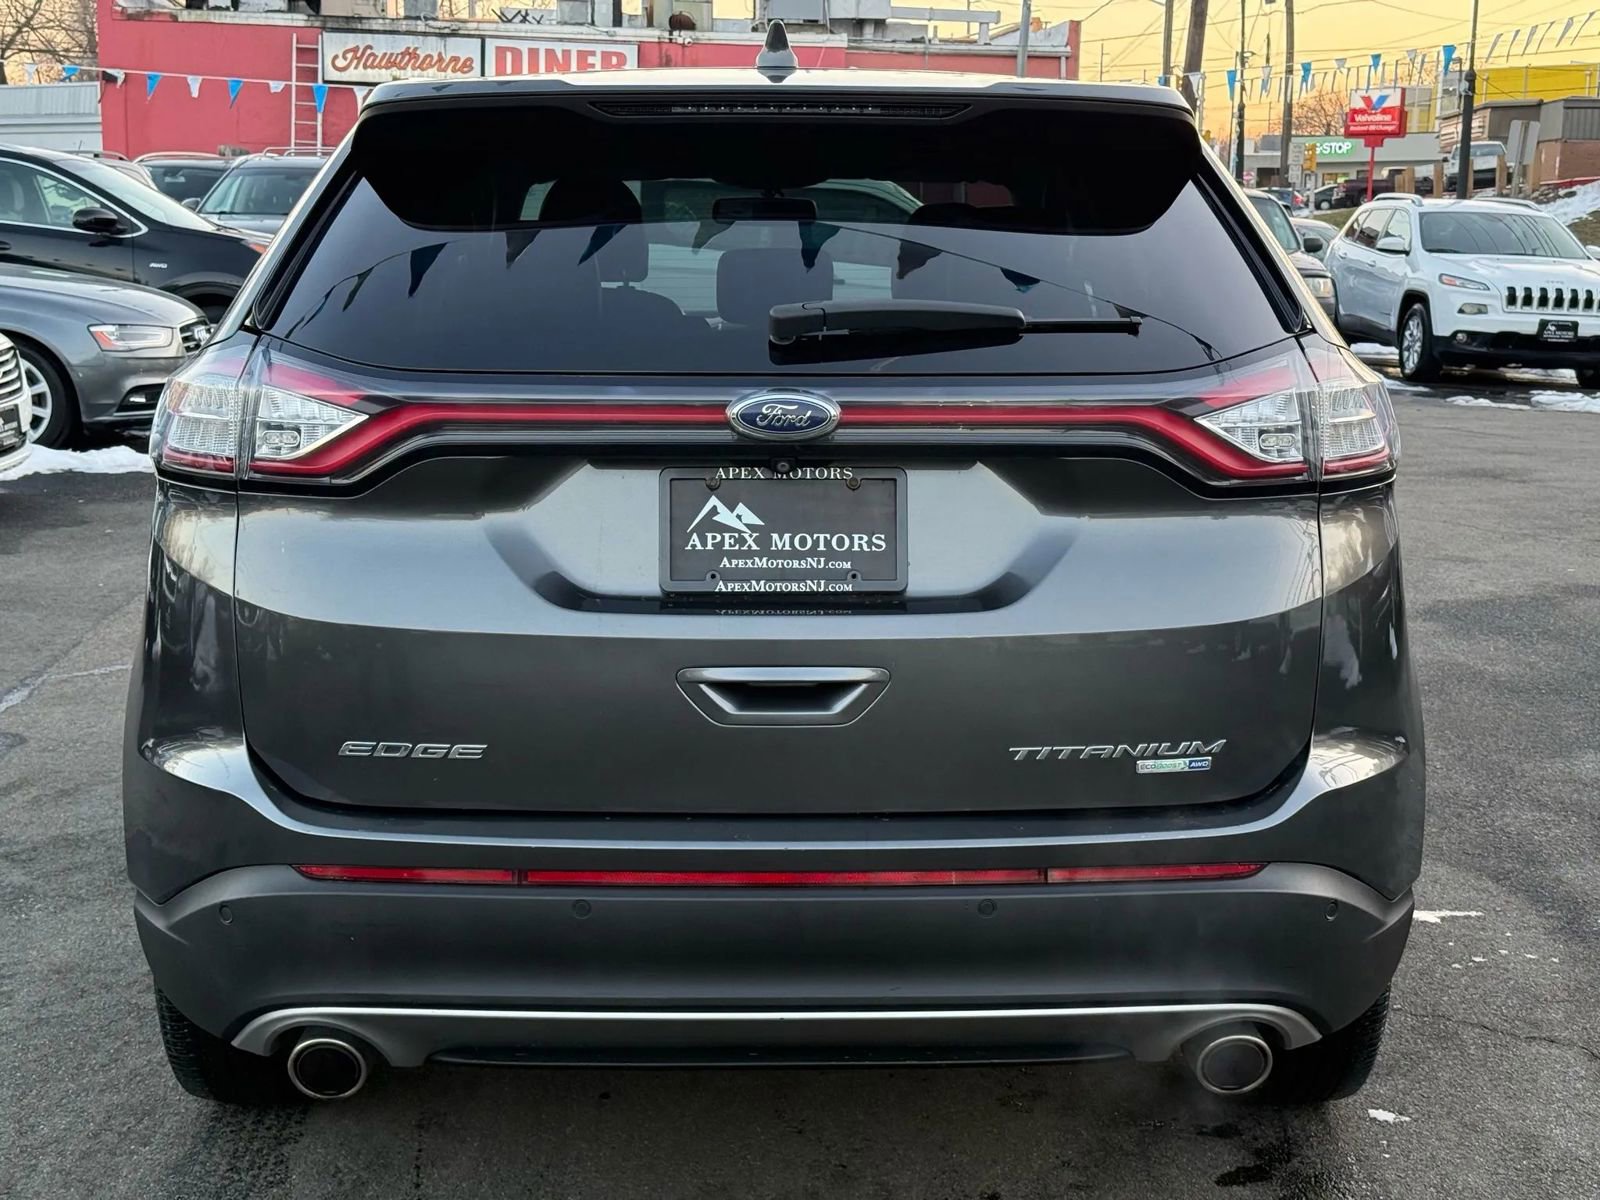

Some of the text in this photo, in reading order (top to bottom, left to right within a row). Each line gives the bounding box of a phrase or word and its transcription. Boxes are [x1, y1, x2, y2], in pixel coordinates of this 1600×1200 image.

[331, 44, 474, 74] Hawthorne
[495, 45, 627, 77] DINER
[1353, 113, 1393, 122] Valvoline
[756, 403, 813, 428] Ford
[715, 467, 766, 480] APEX
[685, 532, 887, 552] APEX MOTORS
[338, 741, 488, 759] EDGE
[1009, 739, 1227, 761] TITANIUM
